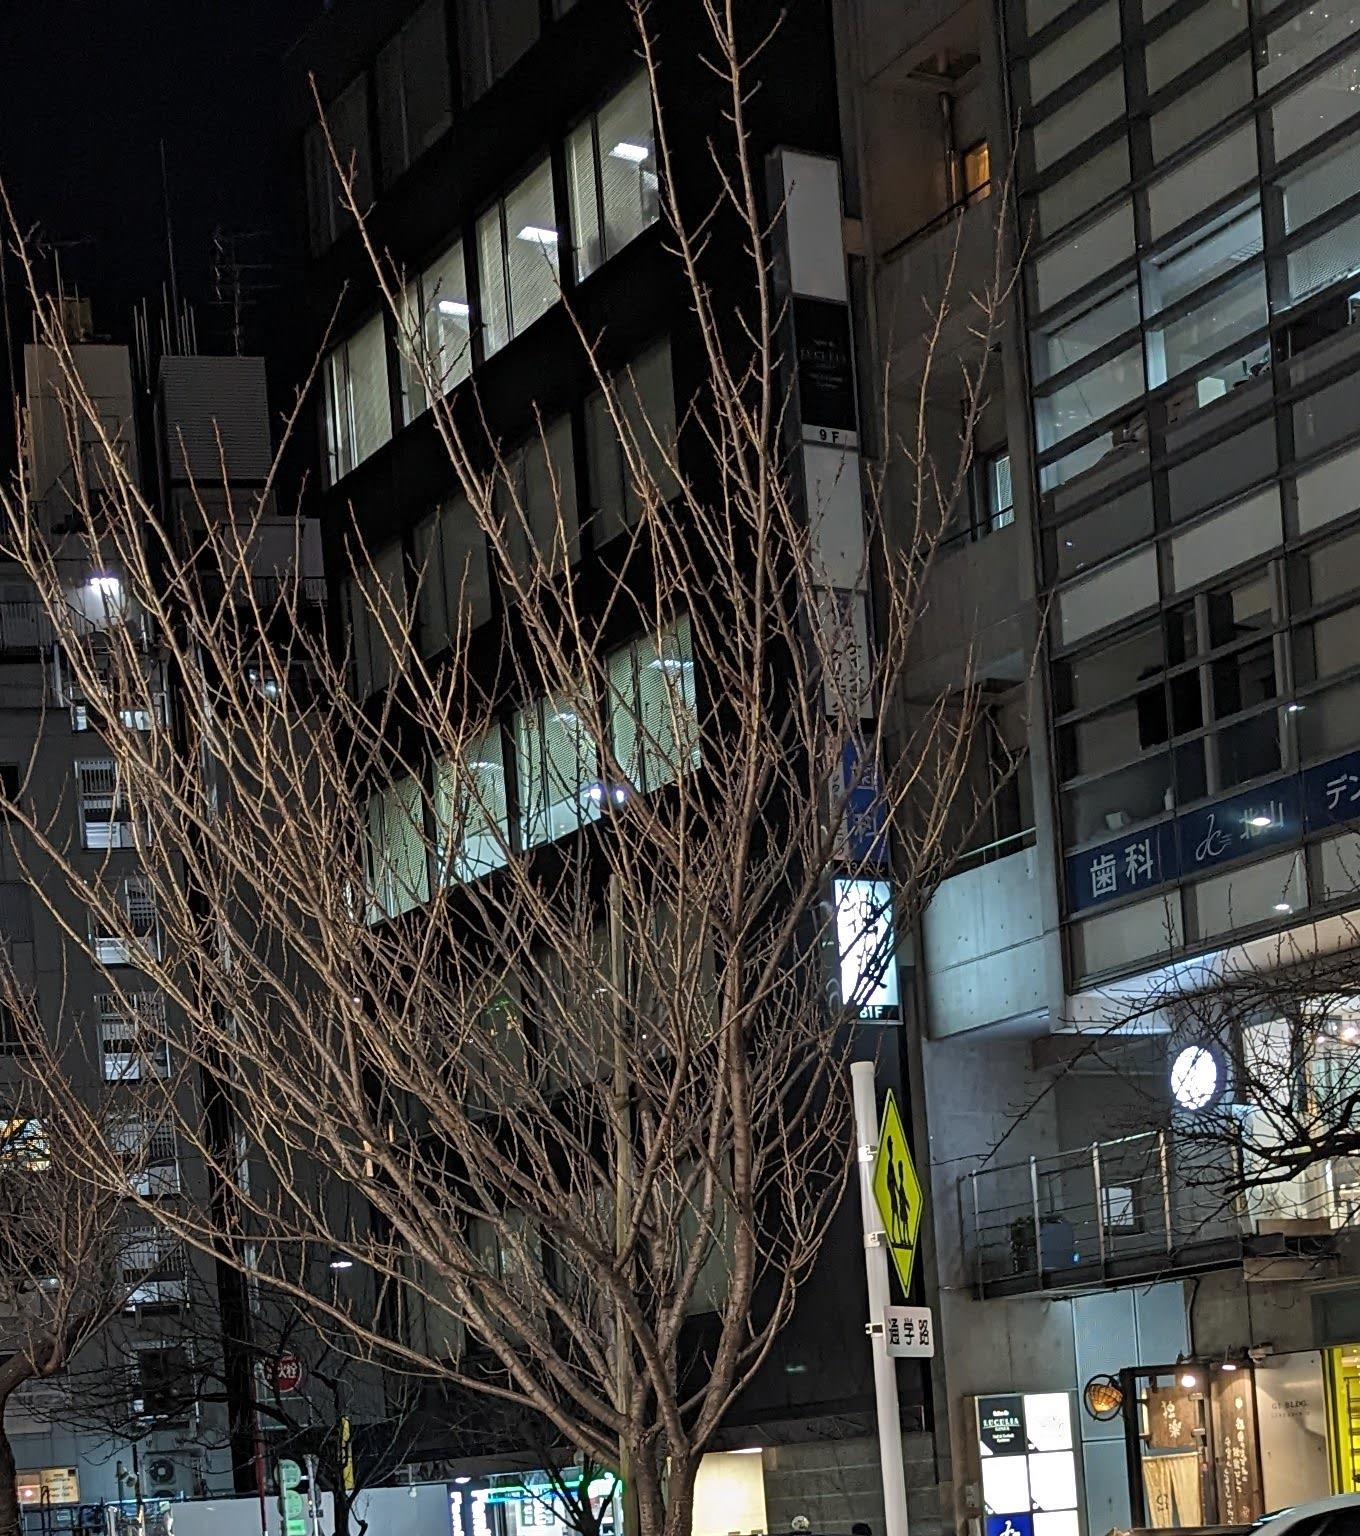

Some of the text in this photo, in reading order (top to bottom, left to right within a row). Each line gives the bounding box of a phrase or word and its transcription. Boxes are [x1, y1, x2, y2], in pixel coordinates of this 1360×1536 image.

[1089, 849, 1155, 898] 歯科
[887, 1317, 930, 1346] 通学路
